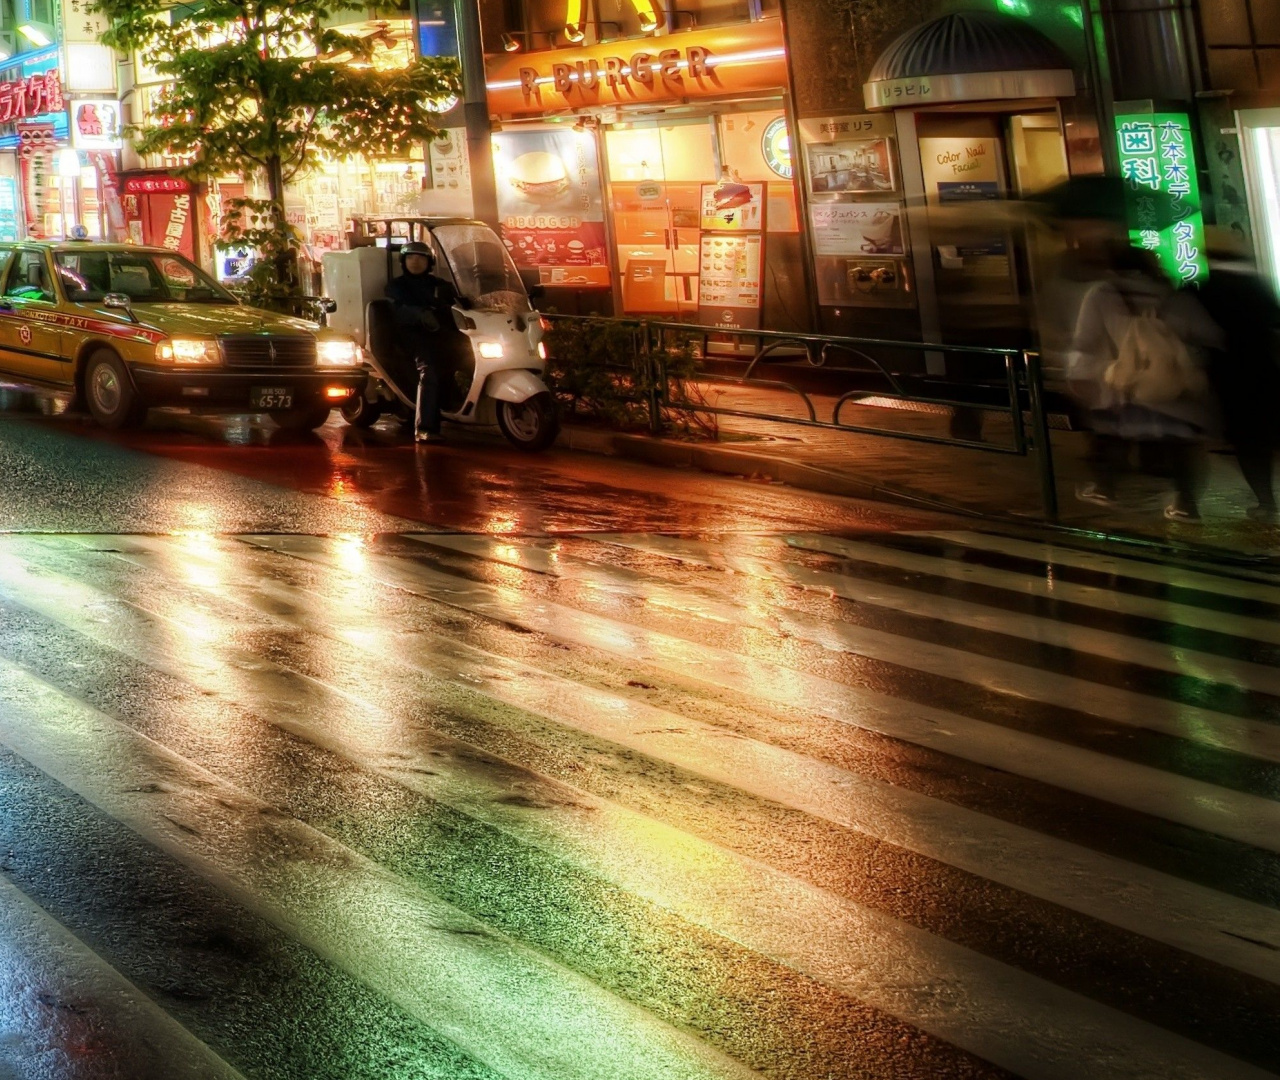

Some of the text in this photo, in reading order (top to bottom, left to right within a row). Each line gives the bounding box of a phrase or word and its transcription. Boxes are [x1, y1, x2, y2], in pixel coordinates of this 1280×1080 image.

[519, 45, 711, 98] R BURGER
[882, 84, 931, 99] リラビル
[851, 119, 874, 132] リラ
[936, 143, 986, 166] Color Nail
[1118, 123, 1162, 191] 歯科
[951, 158, 981, 176] Facial
[63, 315, 89, 328] TAXI
[259, 395, 292, 408] 65-73
